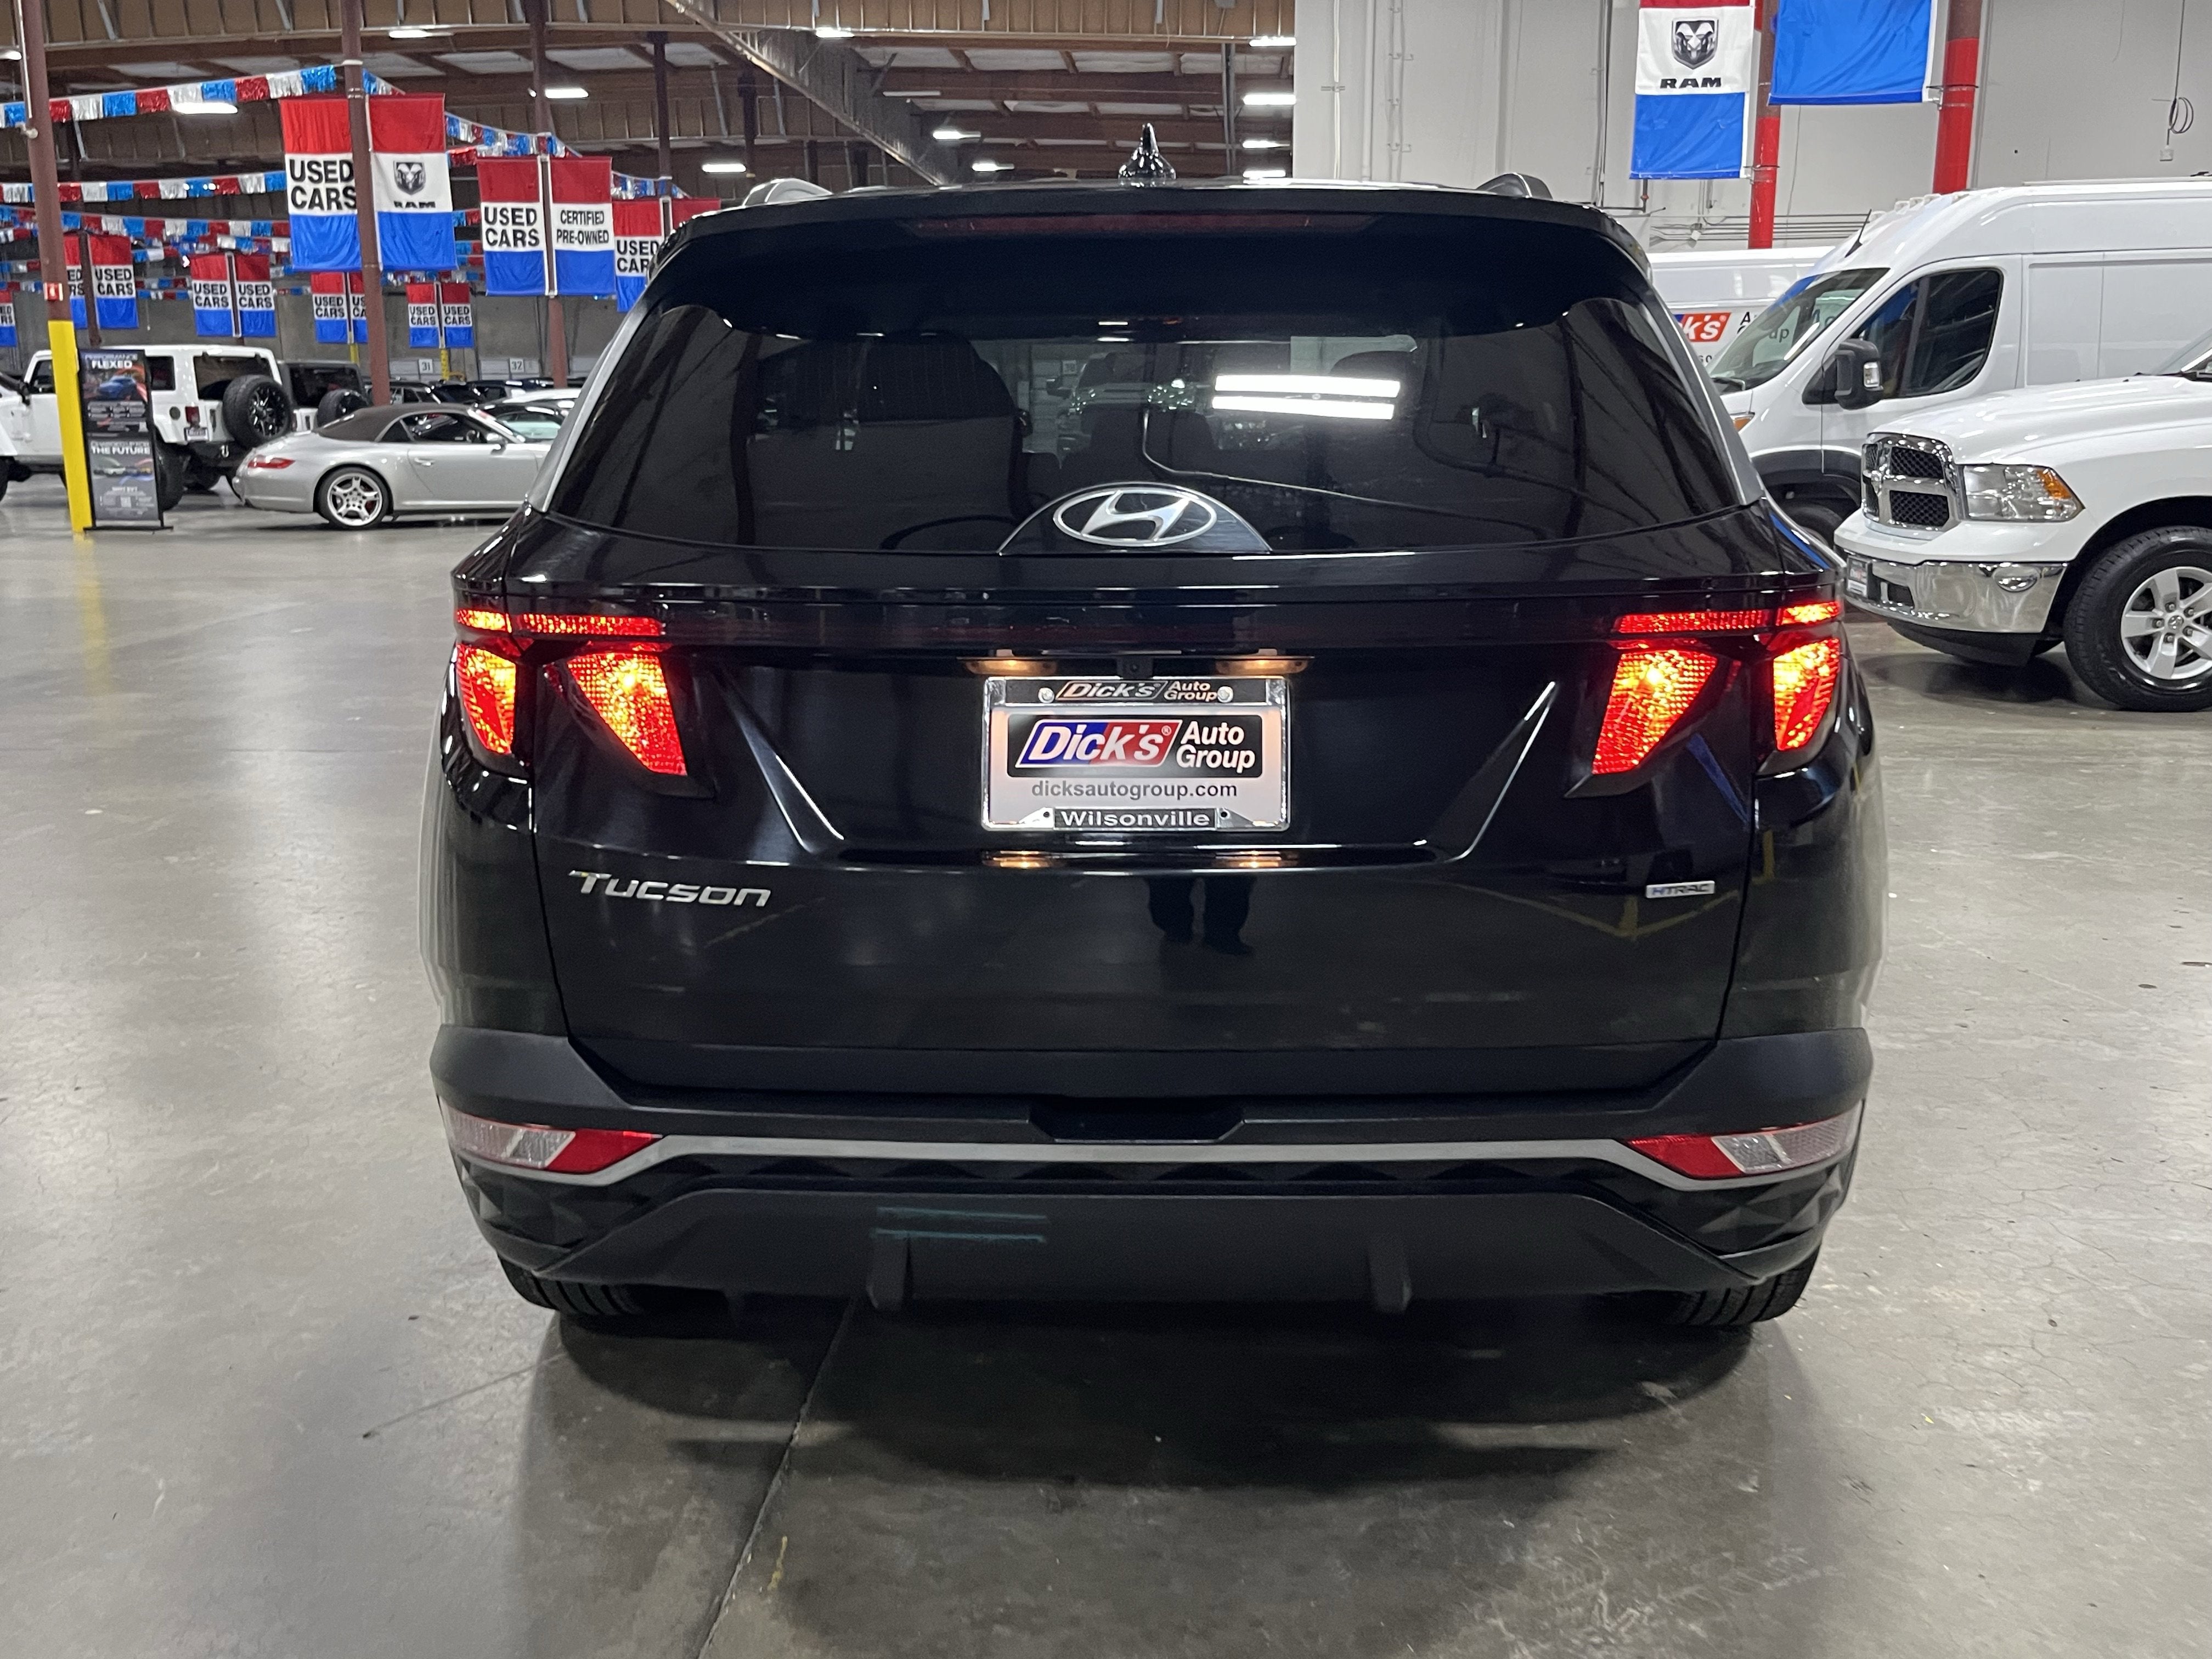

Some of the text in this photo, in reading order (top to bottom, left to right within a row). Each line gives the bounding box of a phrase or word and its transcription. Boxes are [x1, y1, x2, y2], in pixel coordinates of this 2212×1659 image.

[1660, 77, 1722, 88] RAM
[290, 159, 354, 183] USED
[291, 185, 357, 211] CARS
[484, 206, 537, 227] USED
[560, 210, 605, 224] CERTIFIED
[485, 228, 540, 247] CARS
[556, 229, 610, 245] PRE-OWNED
[617, 240, 658, 256] USED
[617, 258, 650, 273] CAR
[95, 268, 132, 280] USED
[98, 283, 133, 295] CARS
[194, 283, 227, 295] USED
[239, 284, 270, 296] USED
[195, 296, 229, 307] CARS
[239, 297, 273, 308] CARS
[314, 296, 344, 306] USED
[315, 308, 345, 318] CARS
[410, 306, 435, 315] USED
[444, 306, 470, 314] USED
[410, 316, 436, 325] CARS
[444, 316, 471, 325] CARS
[92, 360, 132, 369] FLEXED
[421, 362, 431, 371] 31
[511, 360, 522, 370] 32
[1063, 681, 1210, 697] Dick's Auto
[1164, 690, 1218, 702] Group
[1028, 721, 1245, 761] Dick's Auto
[1176, 746, 1255, 774] Group
[1031, 780, 1237, 800] dicksautogroup.com
[1060, 810, 1210, 827] Wilsonville
